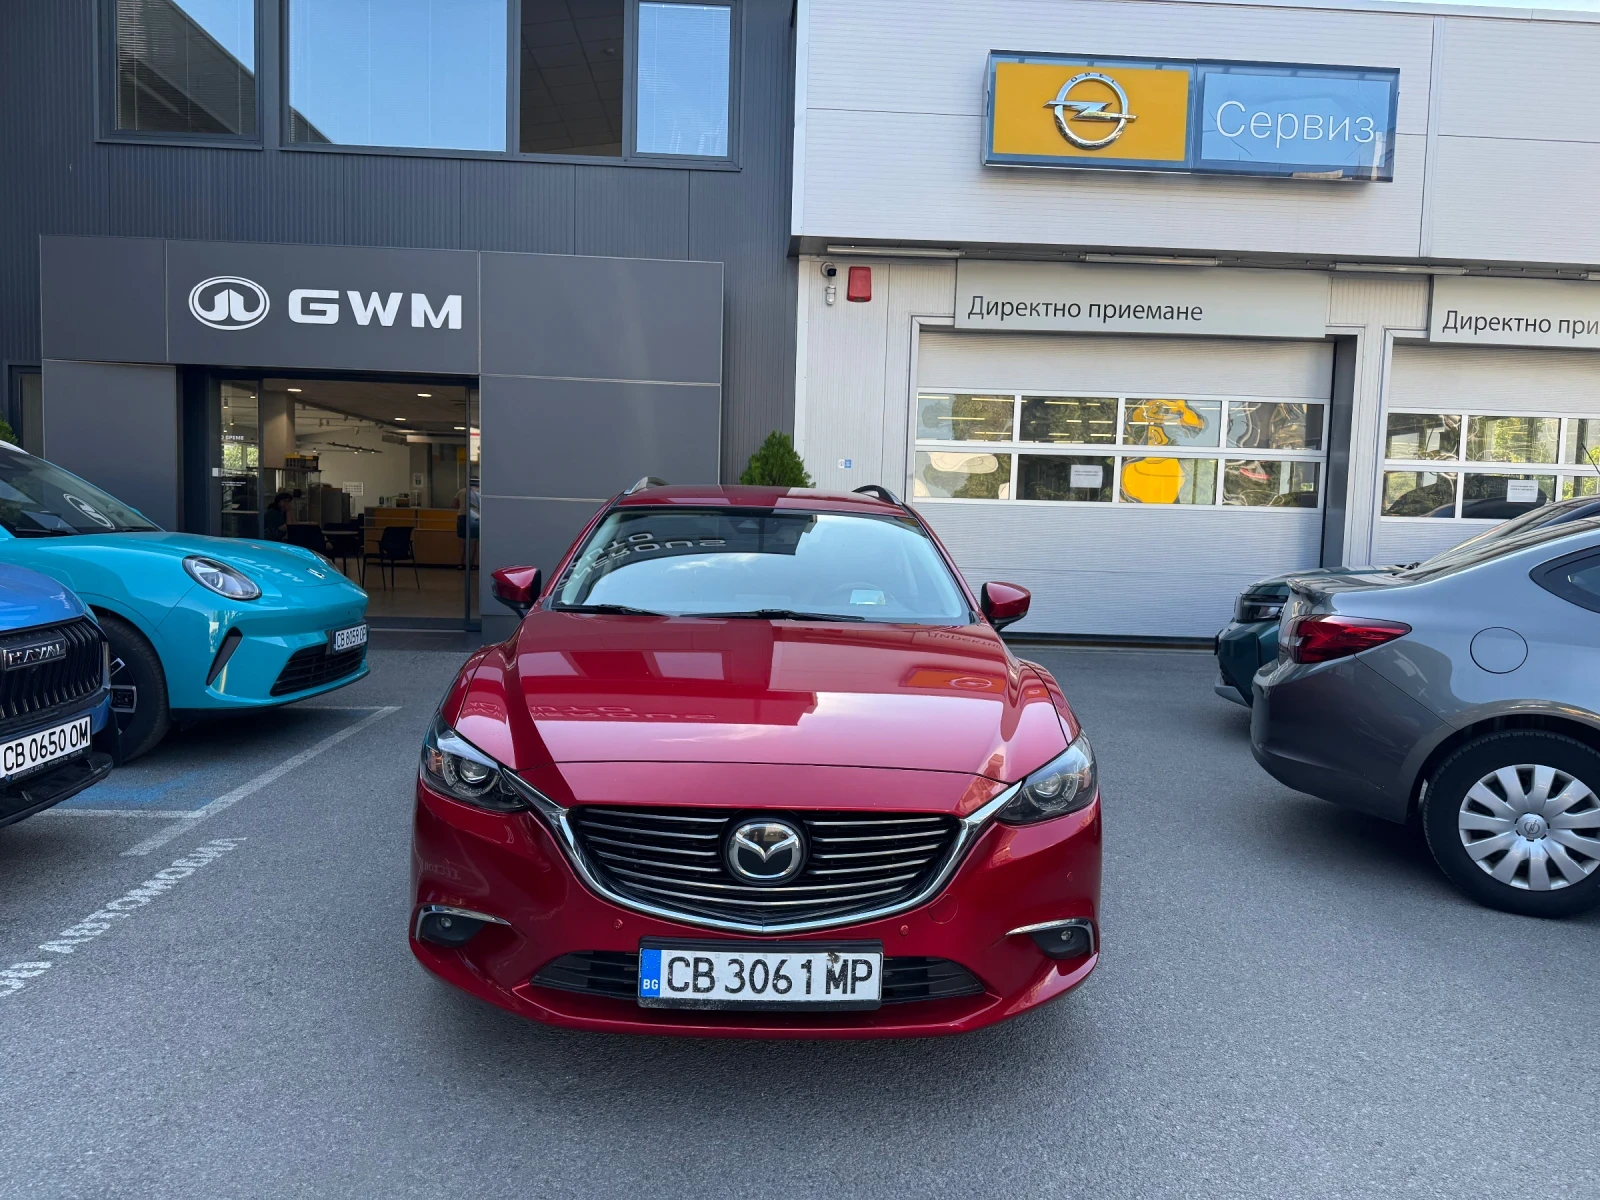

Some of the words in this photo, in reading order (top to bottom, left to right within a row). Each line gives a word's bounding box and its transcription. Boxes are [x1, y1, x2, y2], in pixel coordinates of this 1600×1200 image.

[1070, 72, 1116, 84] OPEL
[1216, 100, 1374, 149] Сервиз
[288, 288, 462, 329] GWM
[967, 295, 1082, 321] Директно
[1088, 303, 1203, 323] приемане
[1442, 310, 1551, 335] Директно
[9, 643, 61, 665] HAVAL
[3, 742, 26, 772] CB
[29, 728, 67, 763] 0650
[69, 720, 89, 749] OM
[642, 978, 659, 990] BG
[667, 956, 716, 993] CB
[724, 958, 813, 995] 3061
[825, 958, 874, 995] MP
